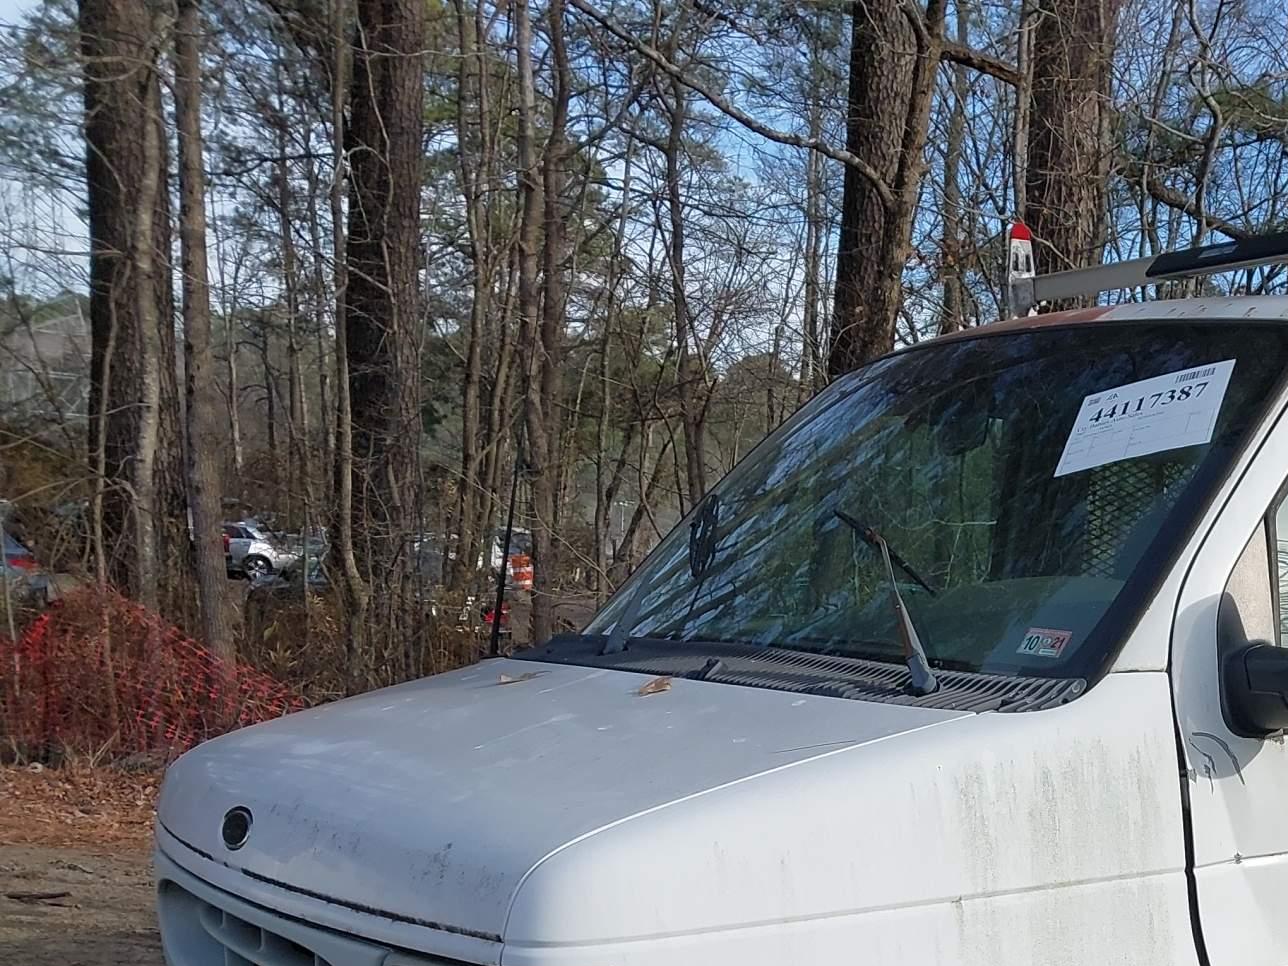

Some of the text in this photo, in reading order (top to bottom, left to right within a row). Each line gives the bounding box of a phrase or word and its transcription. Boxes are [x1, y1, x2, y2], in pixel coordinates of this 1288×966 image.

[1089, 382, 1209, 423] 44117387
[1023, 635, 1066, 651] 10 21
